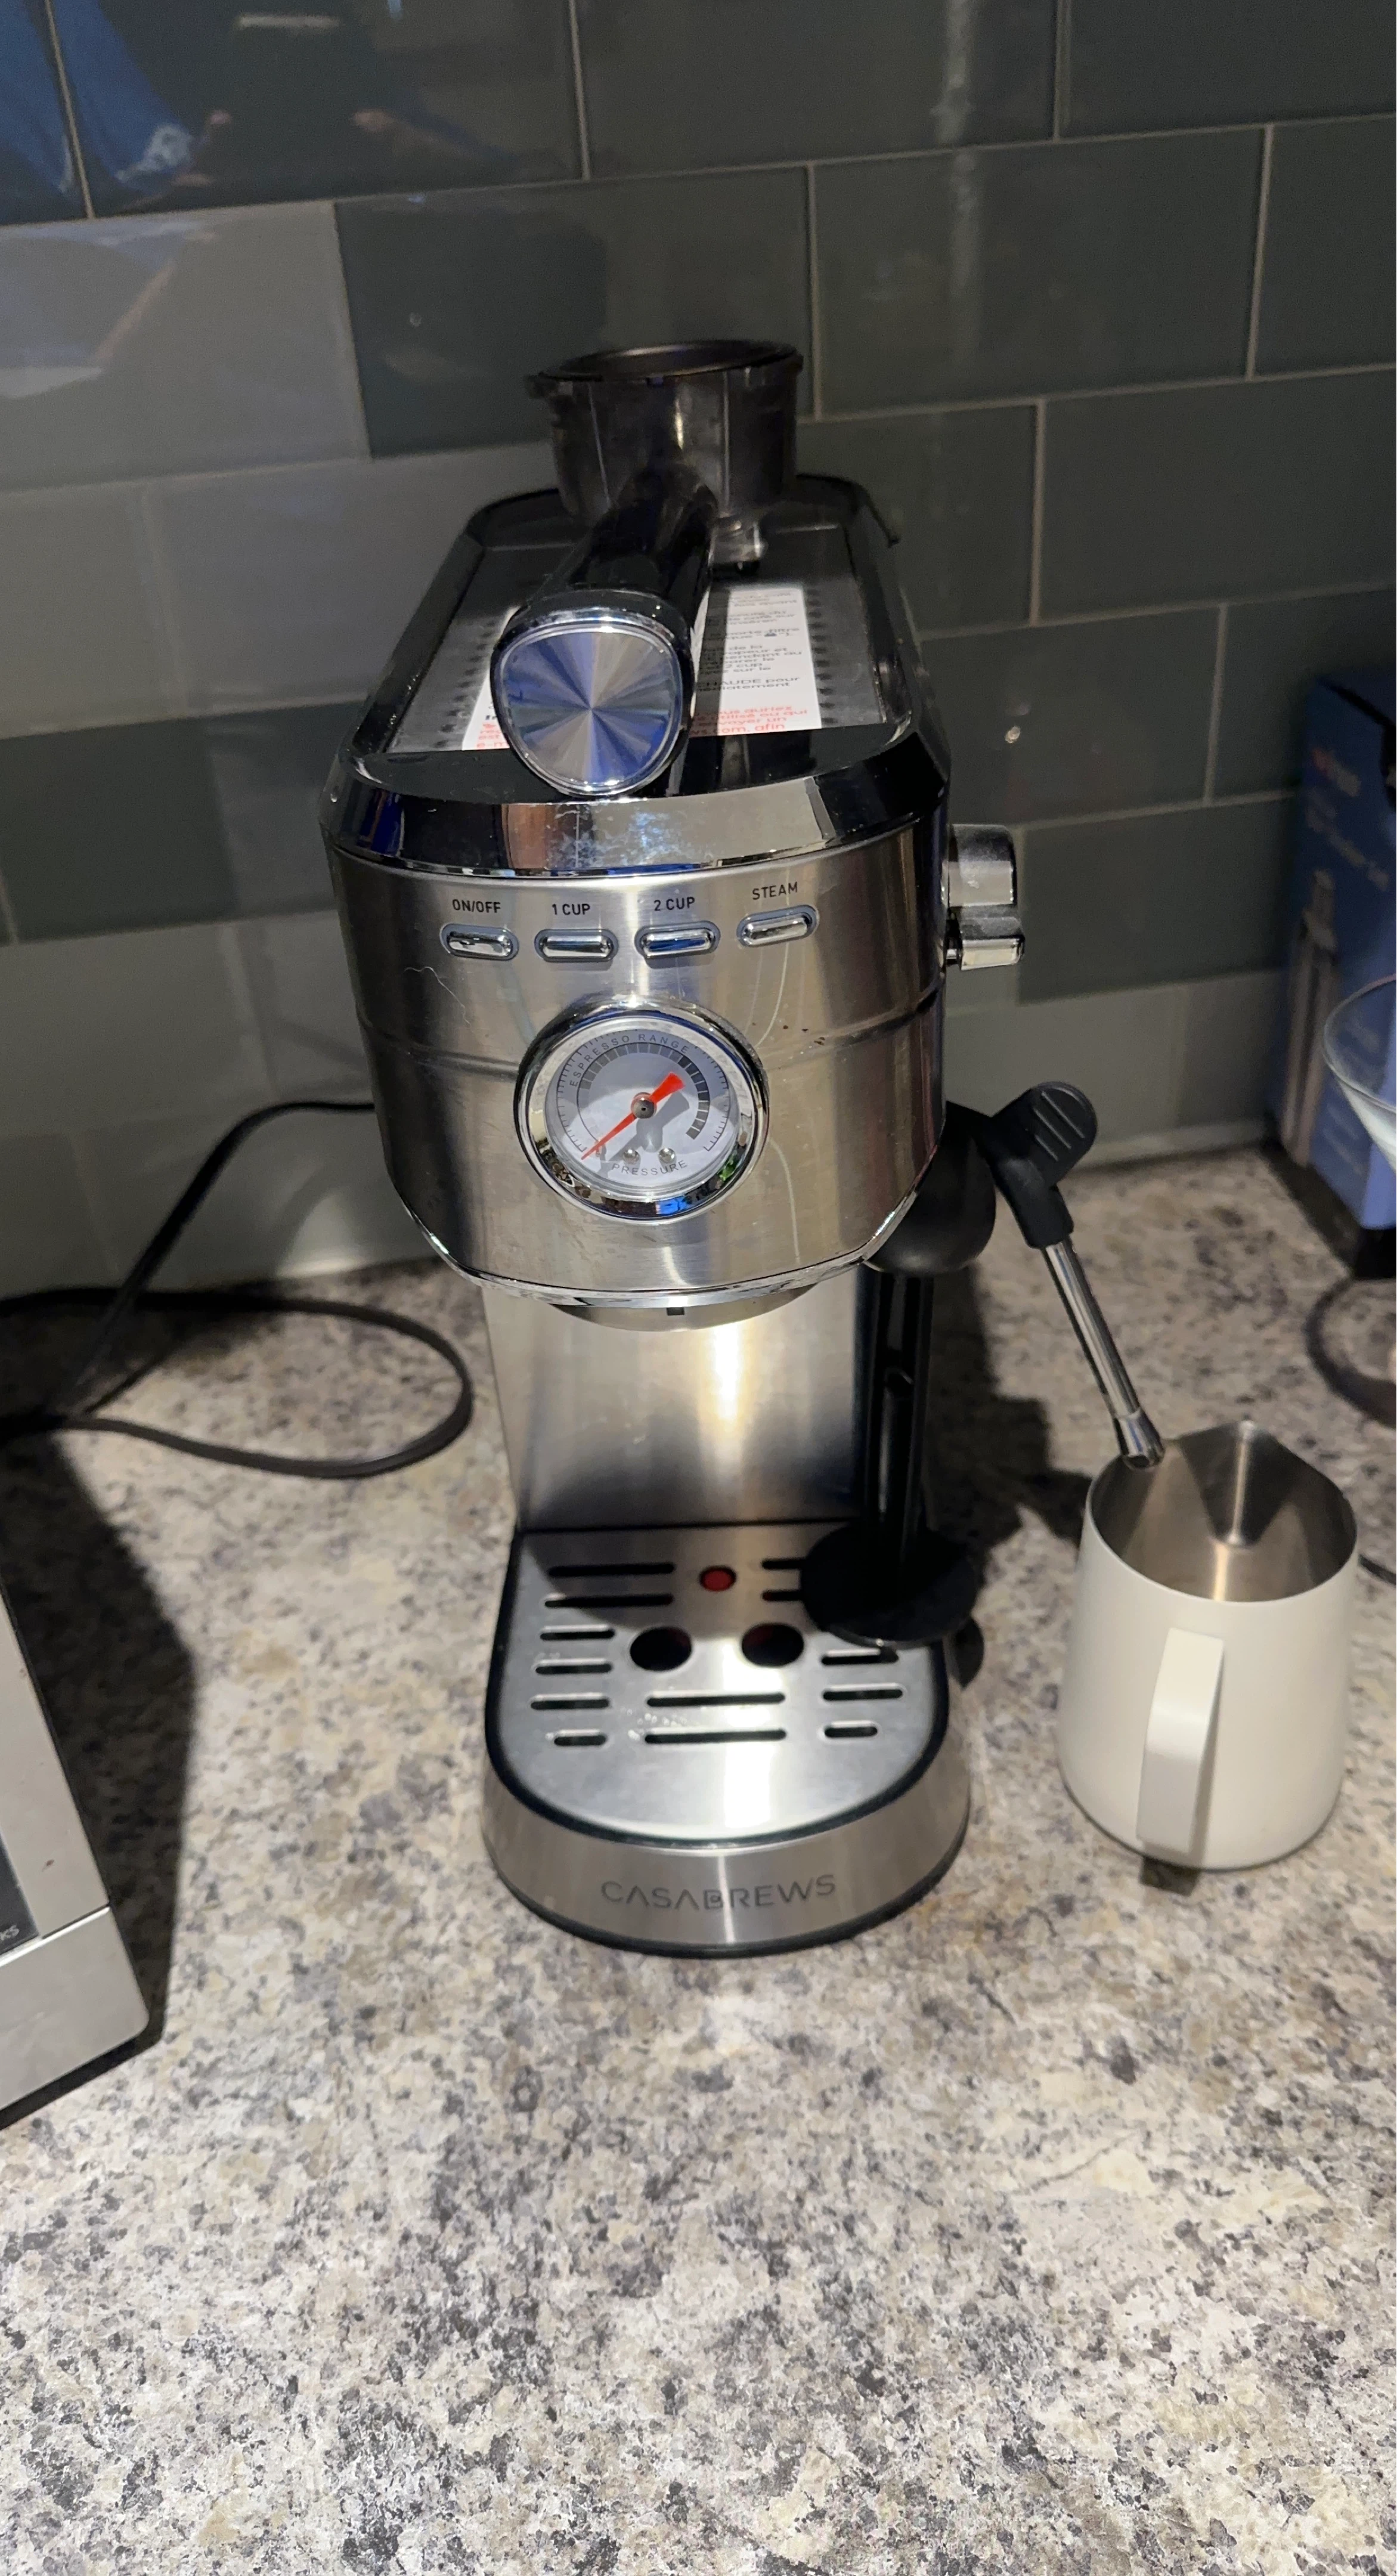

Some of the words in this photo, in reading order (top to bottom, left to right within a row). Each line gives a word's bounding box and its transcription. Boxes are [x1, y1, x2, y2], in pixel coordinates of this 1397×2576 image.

[752, 882, 799, 900] STEAM
[452, 899, 502, 914] ON/OFF
[552, 904, 557, 915] 1
[562, 903, 591, 915] CUP
[653, 900, 662, 911] 2
[665, 896, 696, 911] CUP
[569, 1035, 630, 1087] ESPRESSO
[637, 1033, 690, 1054] RANGE
[611, 1160, 688, 1176] PRESSURE
[600, 1874, 837, 1911] CASABREWS
